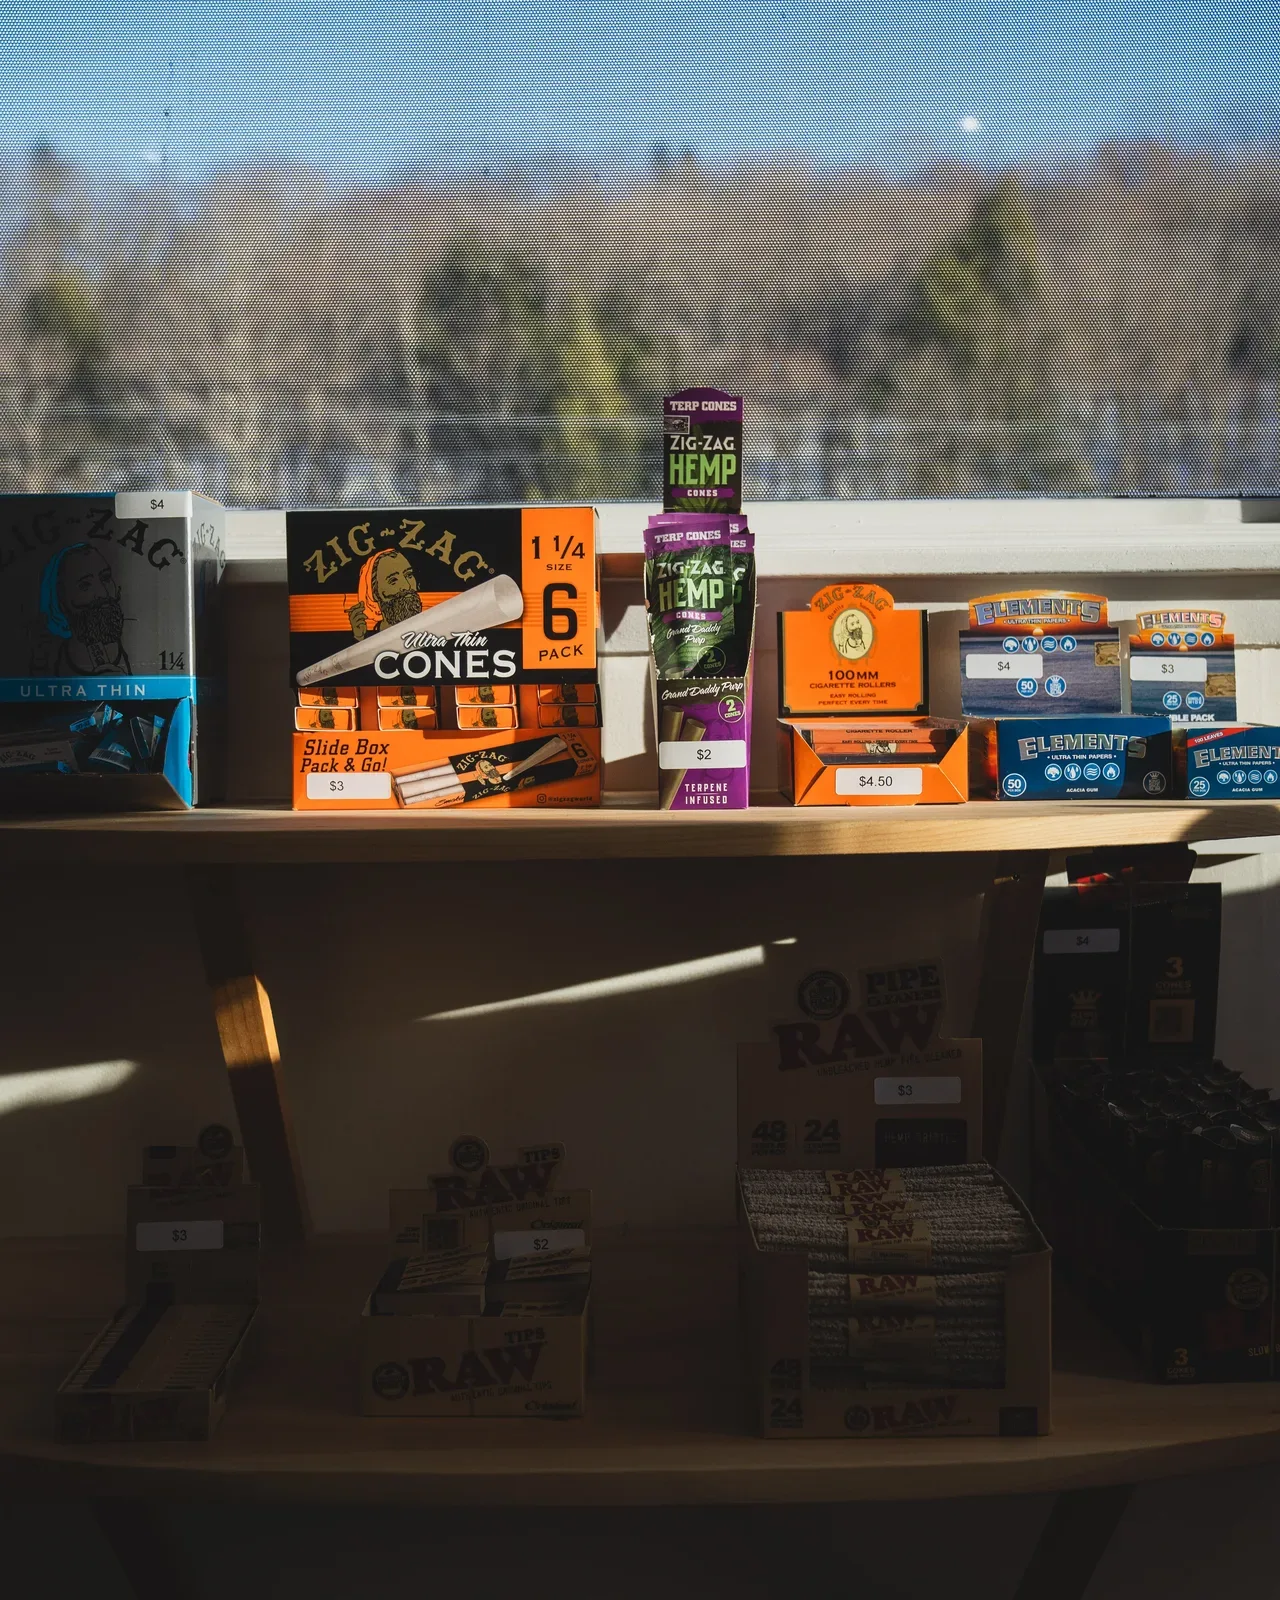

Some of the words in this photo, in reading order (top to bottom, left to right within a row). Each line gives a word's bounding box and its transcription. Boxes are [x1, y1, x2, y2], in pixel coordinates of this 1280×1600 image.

[670, 401, 699, 411] TERP
[701, 401, 737, 411] CONES
[670, 435, 735, 450] ZIG-ZAG
[669, 454, 737, 485] HEMP
[150, 499, 164, 510] $4
[654, 532, 684, 544] TERP
[686, 530, 721, 541] CONES
[303, 518, 488, 584] ZIG-ZAG
[546, 563, 572, 571] SIZE
[656, 560, 725, 580] ZIG-ZAG
[658, 578, 724, 612] HEMP
[814, 585, 889, 613] ZIG-ZAG
[542, 582, 578, 641] 6
[676, 611, 706, 620] CONES
[974, 598, 1101, 626] ELEMENTS
[1140, 612, 1223, 630] ELEMENTS
[667, 624, 692, 640] Grand
[692, 623, 721, 635] Daddy
[685, 634, 706, 646] Purp
[401, 631, 447, 650] Ultra
[450, 631, 488, 648] Thin
[538, 644, 584, 661] PACK
[374, 649, 517, 680] CONES
[997, 660, 1011, 672] $4
[1161, 664, 1175, 674] $3
[20, 685, 87, 698] ULTRA
[97, 684, 146, 696] THIN
[661, 688, 689, 701] Grand
[689, 685, 722, 698] Daddy
[721, 682, 744, 692] Purp
[1021, 681, 1034, 690] 50
[726, 699, 737, 712] 2
[1166, 695, 1178, 703] 25
[724, 711, 742, 719] CONES
[1204, 732, 1224, 741] LEAVES
[303, 738, 349, 756] Slide
[354, 739, 390, 755] Box
[570, 743, 588, 758] 6
[696, 749, 712, 761] $2
[1018, 733, 1149, 761] ELEMENTS
[300, 758, 340, 773] Pack
[343, 759, 354, 772] &
[361, 757, 387, 772] Go!
[456, 751, 508, 771] ZIG-ZAG
[1193, 745, 1280, 769] ELEMENT
[329, 782, 344, 792] $3
[685, 783, 728, 792] TERPENE
[859, 776, 893, 788] $4.50
[1007, 779, 1022, 789] 50
[1193, 780, 1206, 790] 25
[472, 785, 510, 800] ZIG-ZAG
[685, 796, 728, 805] INFUSED
[1076, 936, 1089, 946] $4
[1165, 956, 1184, 979] 3
[866, 965, 941, 994] PIPE
[772, 1001, 945, 1073] RAW
[897, 1085, 914, 1097] $3
[752, 1120, 788, 1142] 48
[804, 1119, 842, 1141] 24
[523, 1146, 561, 1164] TIPS
[430, 1161, 561, 1213] RAW
[837, 1179, 891, 1197] RAW
[171, 1229, 188, 1242] $3
[855, 1222, 914, 1244] RAW
[533, 1238, 549, 1251] $2
[856, 1274, 918, 1296] RAW
[505, 1328, 546, 1345] TIPS
[1173, 1347, 1190, 1366] 3
[1247, 1344, 1270, 1357] SLOW
[408, 1341, 549, 1397] RAW
[771, 1398, 803, 1417] 24
[870, 1395, 960, 1431] RAW
